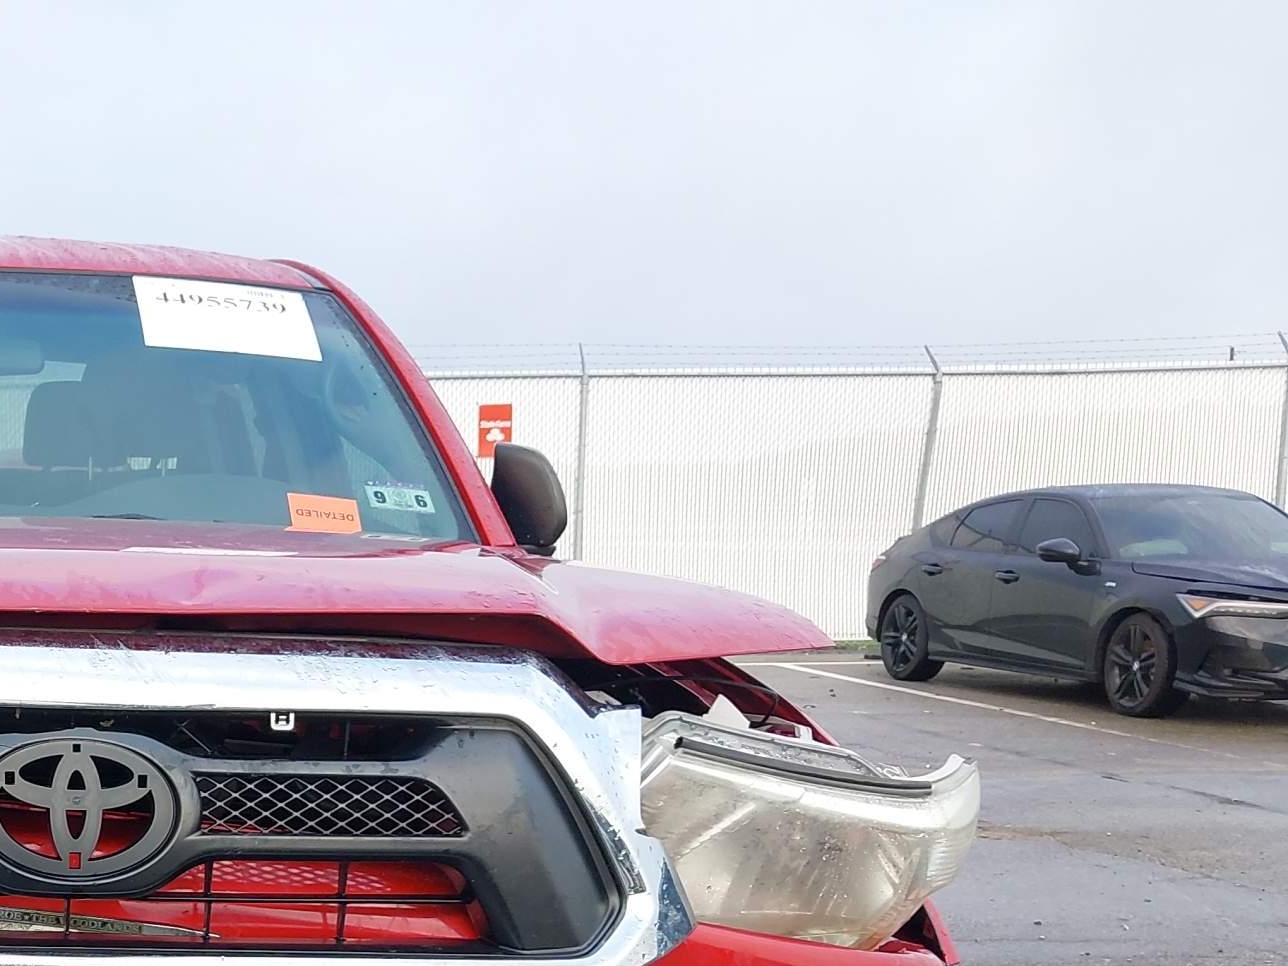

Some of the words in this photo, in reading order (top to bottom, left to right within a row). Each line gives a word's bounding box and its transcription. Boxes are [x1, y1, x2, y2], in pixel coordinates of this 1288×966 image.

[155, 291, 287, 313] 44955739
[295, 508, 355, 522] DETAILED
[30, 912, 58, 925] THE
